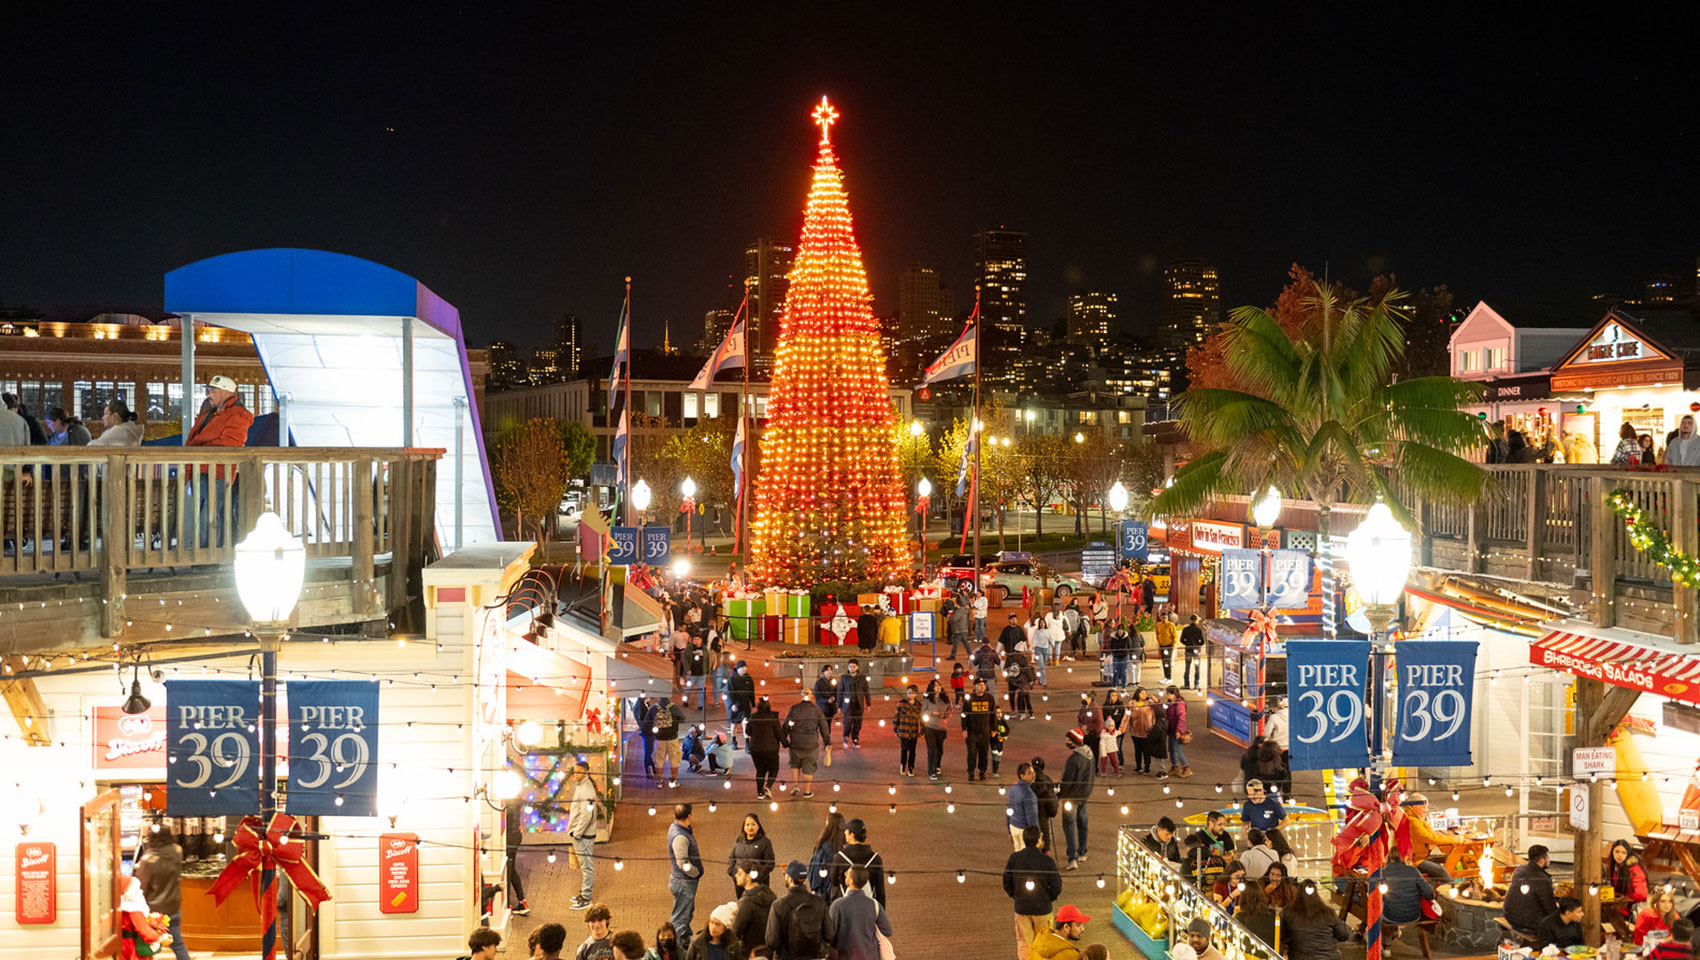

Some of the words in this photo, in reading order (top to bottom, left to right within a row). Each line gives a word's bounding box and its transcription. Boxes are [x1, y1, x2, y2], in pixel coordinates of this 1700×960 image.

[1616, 341, 1638, 358] CAFE
[1646, 373, 1664, 381] SINCE
[1498, 386, 1521, 397] DINNER
[614, 532, 634, 541] PIER
[647, 533, 667, 541] PIER
[1126, 527, 1145, 535] PIER
[1210, 529, 1218, 544] San
[1218, 530, 1240, 547] Francisco
[613, 541, 635, 558] 39
[646, 541, 668, 558] 39
[1125, 535, 1146, 551] 39
[1226, 559, 1255, 570] PIER
[1276, 559, 1304, 570] PIER
[1224, 571, 1256, 597] 39
[1273, 571, 1305, 597] 39
[1298, 664, 1359, 687] PIER
[1406, 664, 1464, 687] PIER
[1605, 664, 1653, 689] SALADS
[178, 705, 247, 729] PIER
[299, 706, 367, 730] PIER
[1297, 689, 1362, 744] 39
[1401, 689, 1466, 742] 39
[176, 732, 250, 789] 39
[297, 732, 370, 789] 39
[1575, 752, 1590, 760] MAN
[1591, 752, 1613, 760] EATING
[1583, 761, 1605, 769] SHARK
[385, 845, 413, 859] Biscoff
